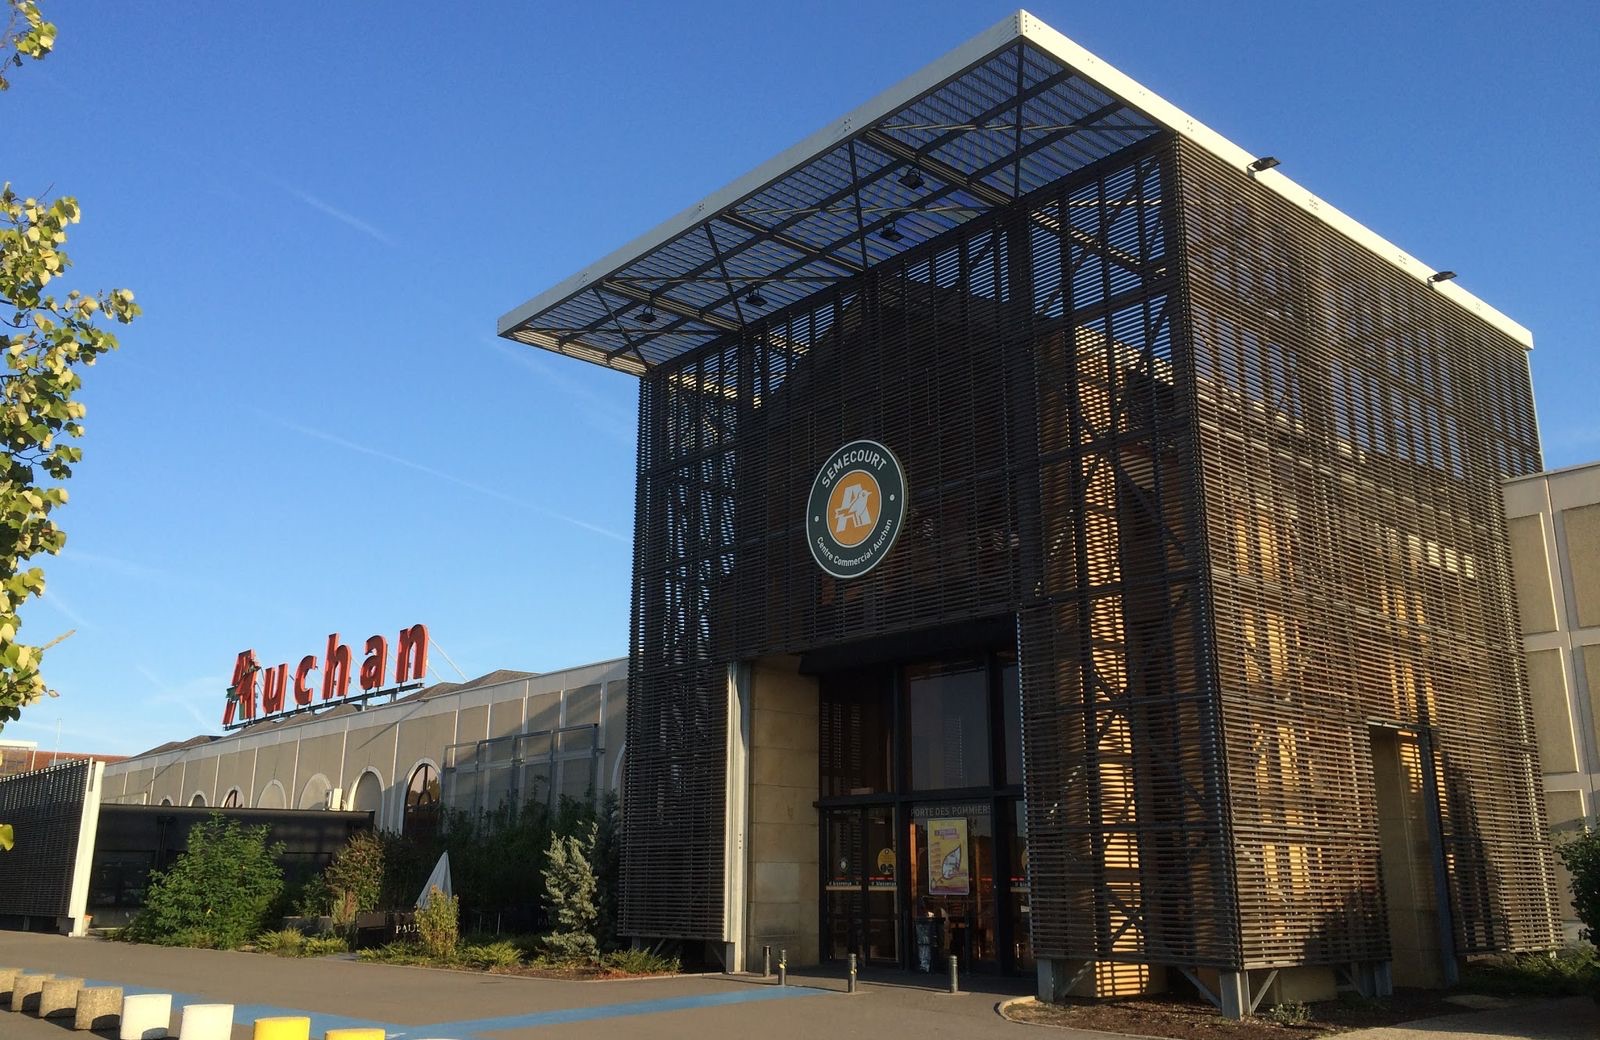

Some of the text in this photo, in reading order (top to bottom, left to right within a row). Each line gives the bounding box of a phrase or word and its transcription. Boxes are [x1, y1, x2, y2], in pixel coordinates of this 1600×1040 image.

[821, 449, 887, 488] SEMECOURT
[817, 519, 892, 567] Centre Commercial Auchan
[222, 623, 430, 724] Auchan
[911, 807, 934, 817] PORTE
[935, 807, 950, 816] DES
